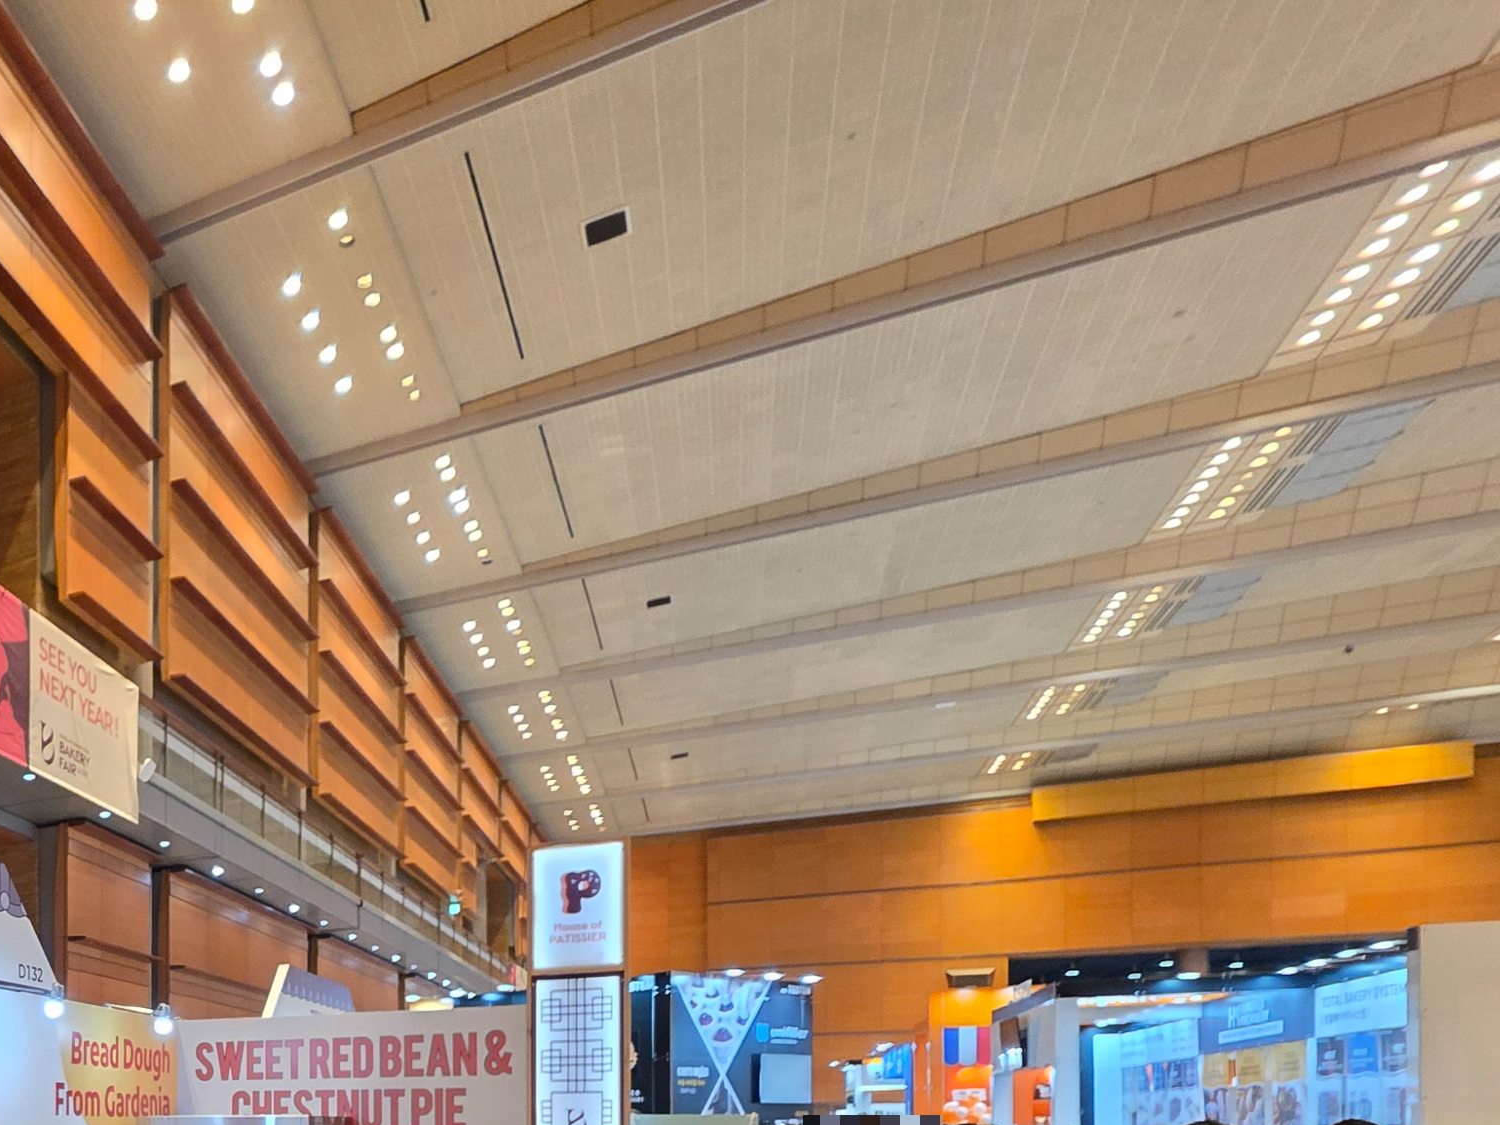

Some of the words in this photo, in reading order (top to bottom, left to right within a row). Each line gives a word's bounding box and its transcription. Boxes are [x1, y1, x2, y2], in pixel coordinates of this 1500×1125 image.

[38, 636, 66, 674] SEE
[68, 655, 98, 694] YOU
[39, 667, 77, 711] NEXT
[18, 963, 44, 983] D132
[71, 1031, 120, 1069] Bread
[123, 1038, 171, 1081] Dough
[194, 1038, 304, 1082] SWEET
[309, 1036, 375, 1080] RED
[379, 1031, 478, 1079] BEAN
[484, 1029, 513, 1076] &
[55, 1082, 100, 1117] From
[104, 1085, 171, 1118] Gardenia
